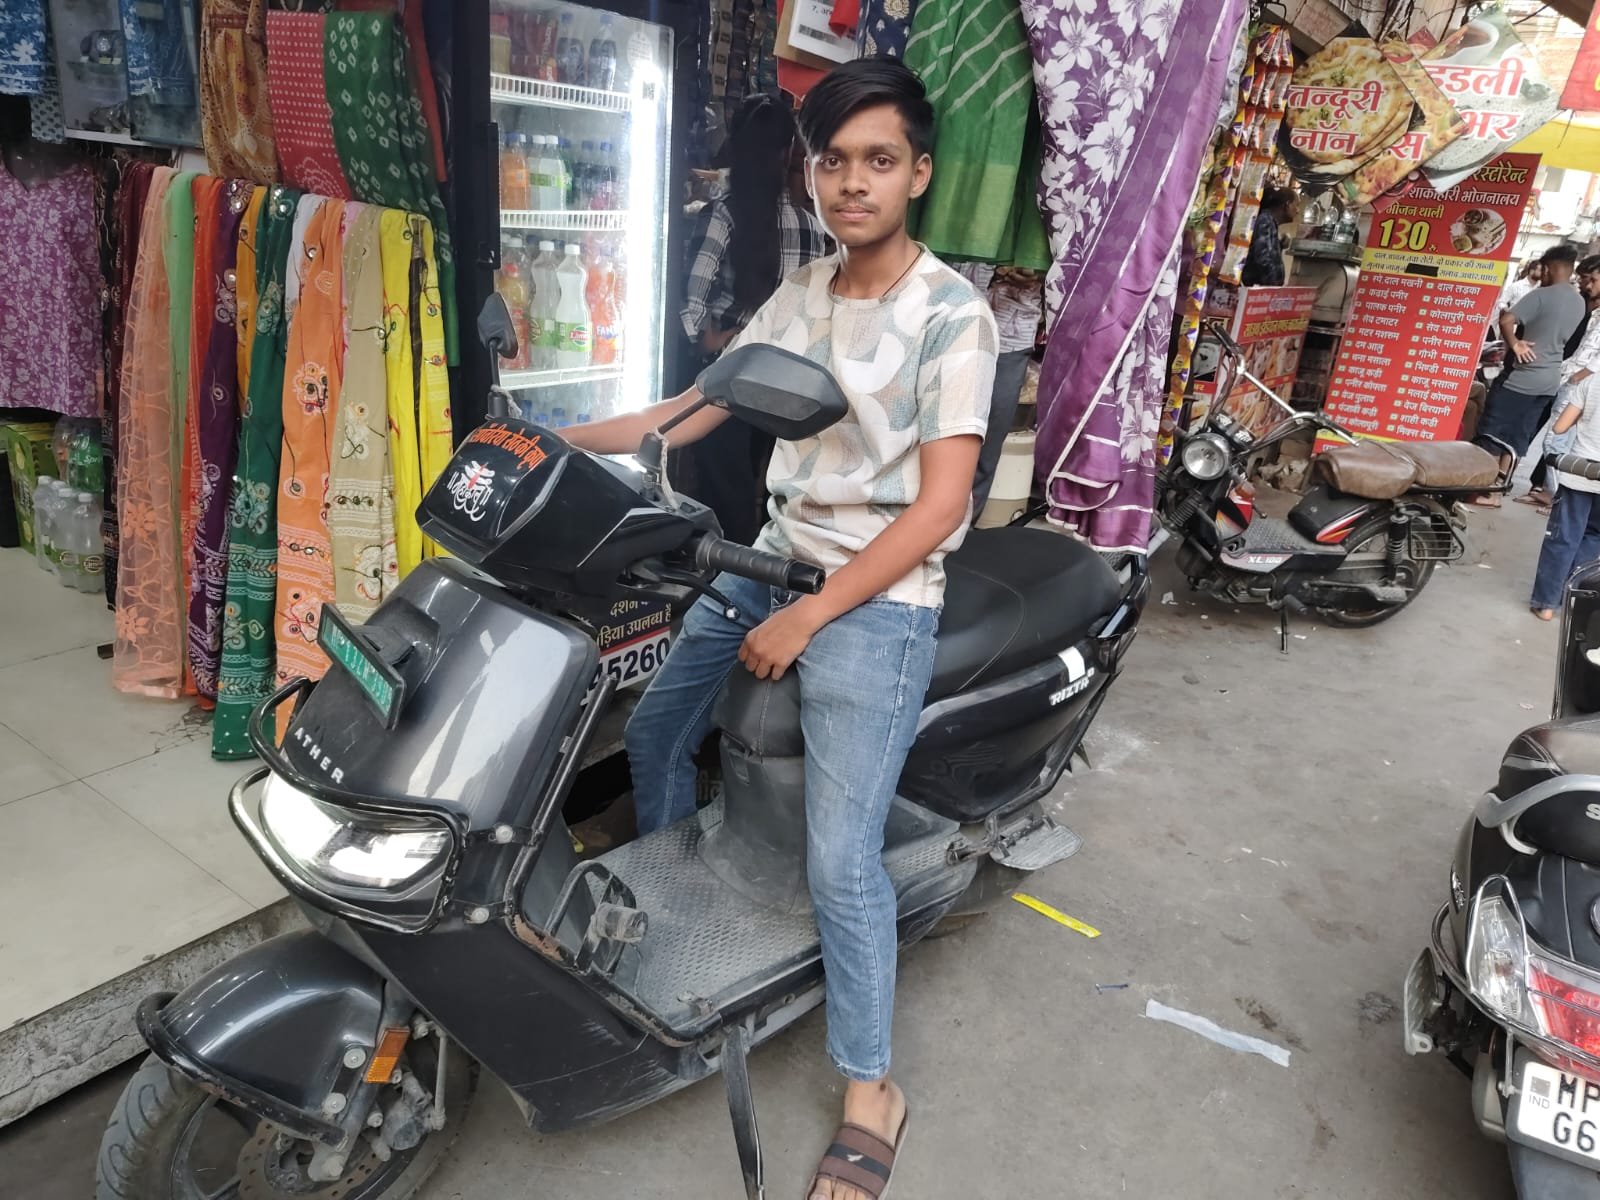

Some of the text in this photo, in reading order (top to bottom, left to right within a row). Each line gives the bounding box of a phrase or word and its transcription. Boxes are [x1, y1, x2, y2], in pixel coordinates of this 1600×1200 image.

[1288, 80, 1385, 119] तन्दूरी
[1291, 120, 1359, 155] नॉन
[1418, 203, 1445, 218] थाली
[1460, 190, 1520, 206] भोजनालय
[1380, 219, 1430, 251] 130
[626, 611, 663, 633] उपलब्ध
[294, 727, 345, 784] ATHER
[1529, 1095, 1550, 1109] IND
[1553, 1111, 1597, 1152] G6
